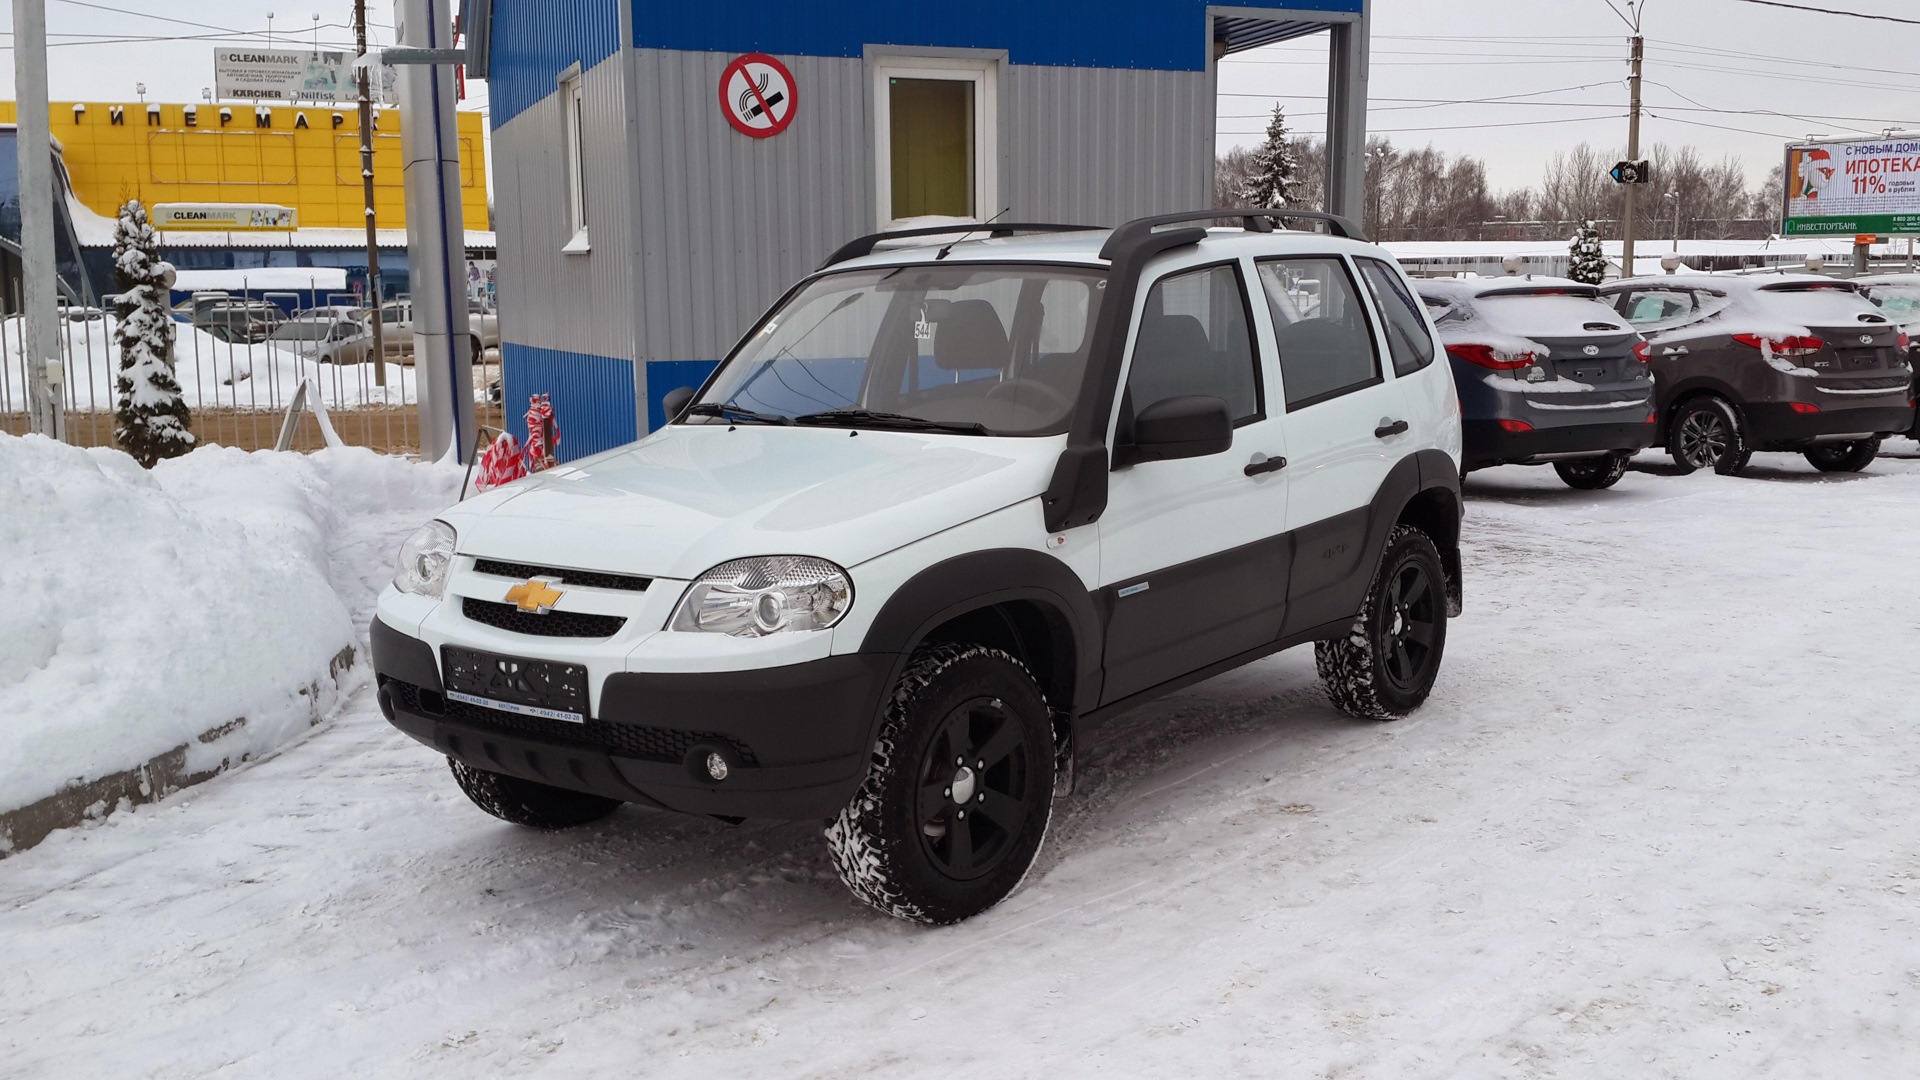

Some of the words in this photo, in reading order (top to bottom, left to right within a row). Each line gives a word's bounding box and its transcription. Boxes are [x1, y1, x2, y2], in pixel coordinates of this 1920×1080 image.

[229, 53, 299, 64] CLEANMARK
[301, 92, 335, 100] Nilfisk
[1845, 146, 1853, 155] С
[1854, 144, 1893, 155] НОВЫМ
[1895, 142, 1920, 154] ДОМ
[1852, 175, 1886, 194] 11%
[1796, 222, 1858, 231] ИНВЕСТТОРГБАНК
[915, 323, 929, 338] 544
